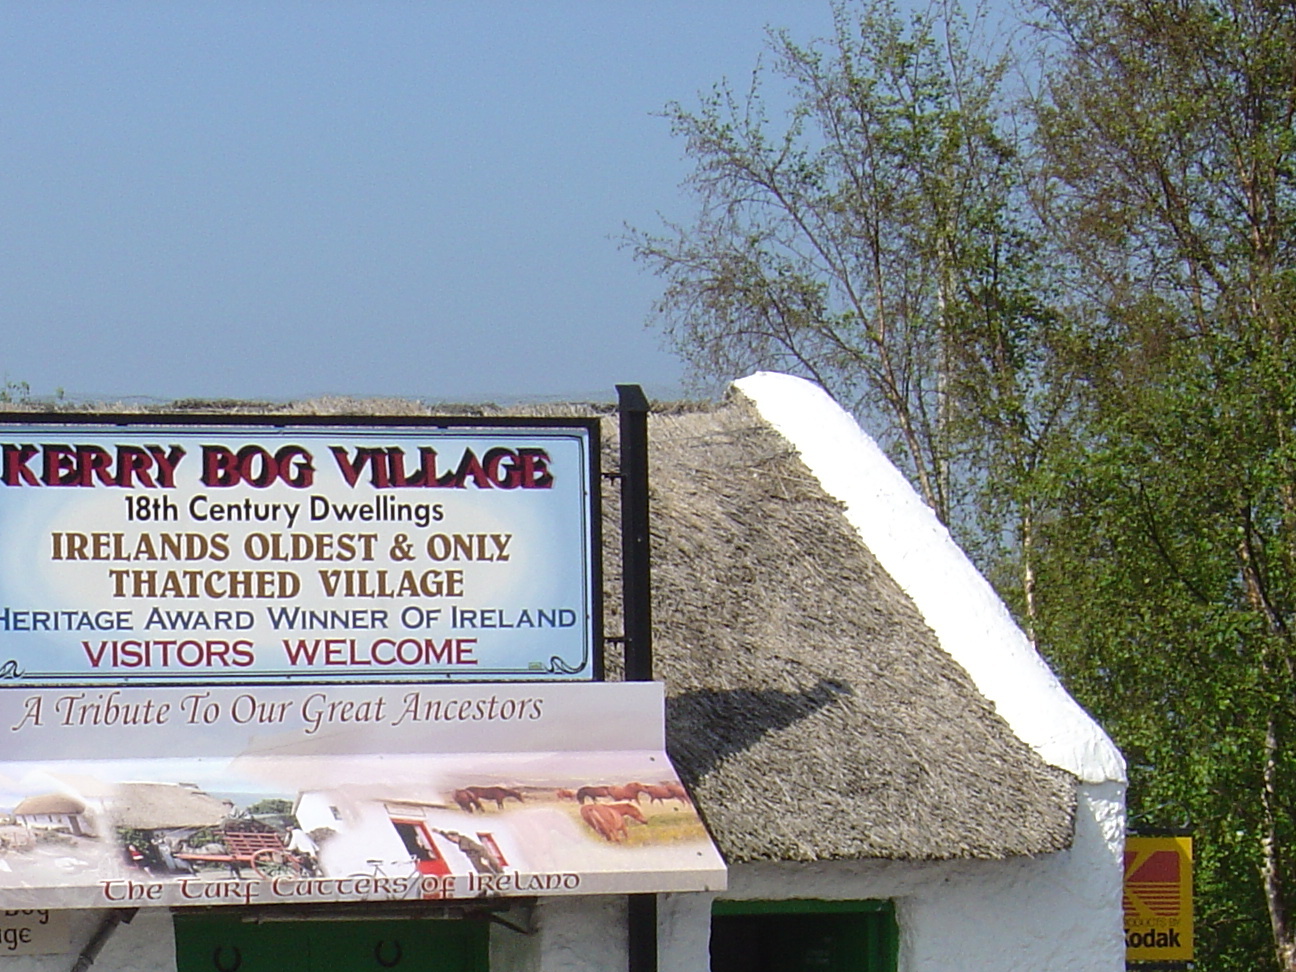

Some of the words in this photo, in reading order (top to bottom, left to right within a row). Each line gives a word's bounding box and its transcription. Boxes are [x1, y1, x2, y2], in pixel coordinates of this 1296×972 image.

[0, 443, 186, 488] KERRY
[200, 444, 316, 488] BOG
[328, 446, 554, 489] VILLAGE
[124, 495, 178, 521] 18th
[189, 495, 300, 528] Century
[310, 495, 444, 527] Dwellings
[51, 532, 230, 562] IRELANDS
[244, 533, 378, 562] OLDEST
[389, 533, 416, 562] &
[427, 533, 512, 562] ONLY
[109, 569, 301, 598] THATCHED
[318, 569, 464, 598] VILLAGE
[81, 640, 255, 668] VISITORS
[283, 638, 478, 666] WELCOME
[12, 696, 43, 731] A
[55, 691, 170, 726] Tribute
[180, 692, 220, 724] To
[231, 694, 293, 724] Our
[301, 693, 388, 734] Great
[391, 692, 544, 726] Ancestors
[100, 880, 163, 900] The
[176, 878, 260, 904] Turf
[421, 874, 456, 898] of
[468, 870, 580, 892] Ireland
